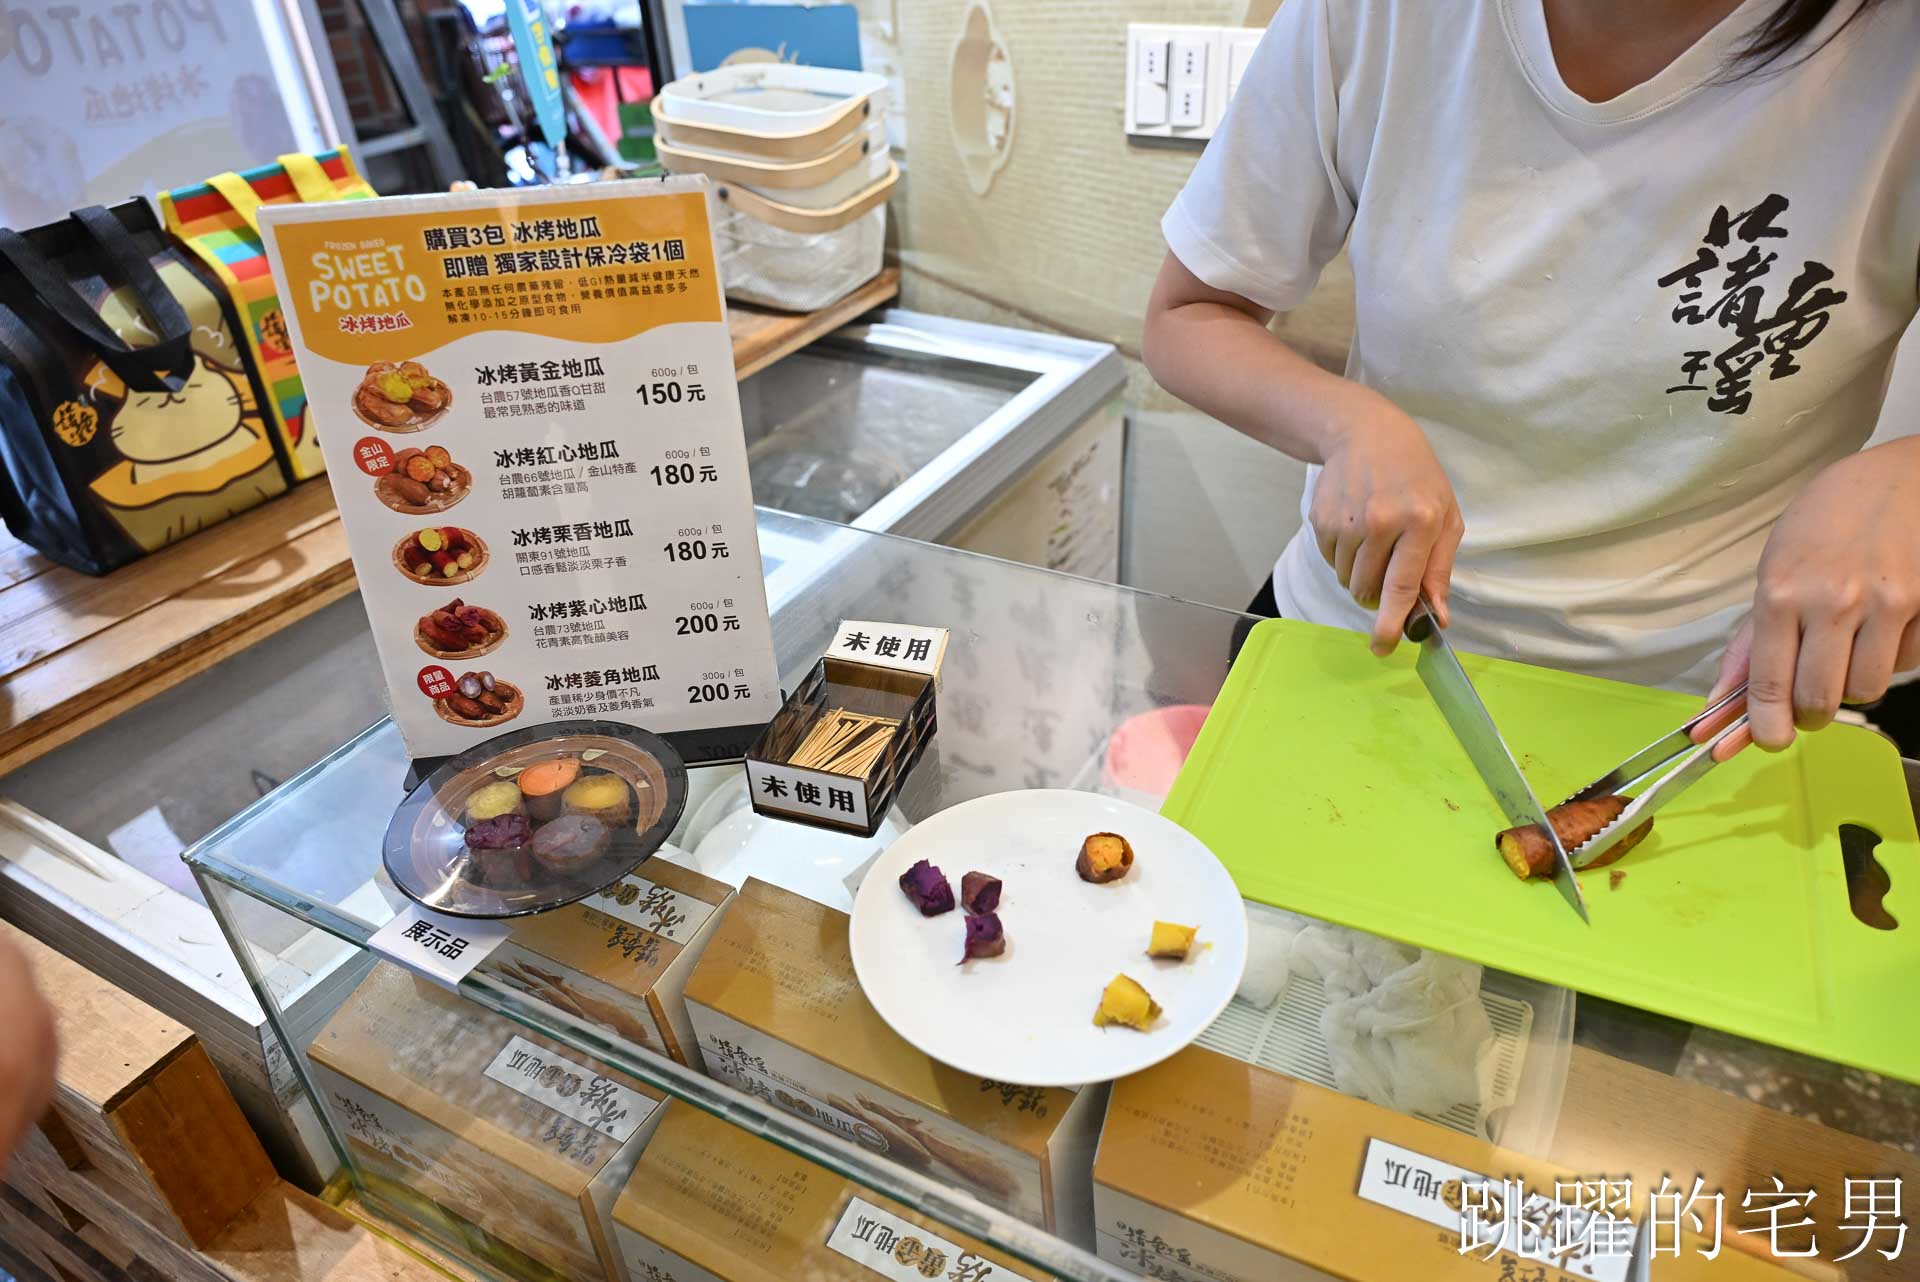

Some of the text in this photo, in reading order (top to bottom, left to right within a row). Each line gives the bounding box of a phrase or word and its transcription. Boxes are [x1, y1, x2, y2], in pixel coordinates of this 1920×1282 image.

[424, 216, 602, 251] 購買3包 冰烤地瓜
[312, 244, 404, 281] SWEET
[443, 239, 685, 279] 即贈 獨家設計保冷袋1個
[309, 274, 426, 312] POTATO
[340, 312, 411, 332] 冰烤地瓜
[475, 357, 605, 386] 冰烤黃金地瓜
[651, 367, 677, 378] 600g
[687, 364, 699, 375] 包
[481, 382, 606, 405] 台農57號地瓜香Q甘甜
[636, 381, 706, 406] 150 元
[484, 400, 585, 418] 最常見熟悉的味道
[360, 443, 383, 459] 金山
[493, 440, 620, 469] 冰烤紅心地瓜
[665, 450, 690, 460] 600g
[700, 447, 710, 457] 包
[365, 456, 391, 472] 限定
[499, 467, 576, 486] 台農66號地瓜
[587, 462, 638, 477] 金山特產
[650, 463, 718, 486] 180 元
[511, 518, 634, 547] 冰烤栗香地瓜
[678, 528, 702, 537] 600g
[712, 525, 723, 535] 包
[664, 540, 730, 563] 180 元
[519, 556, 627, 576] 口感香鬆淡淡栗子香
[528, 594, 648, 621] 冰烤紫心地瓜
[690, 602, 714, 611] 600g
[723, 599, 734, 608] 包
[534, 619, 606, 637] 台農73號地瓜
[675, 613, 740, 636] 200 元
[843, 631, 932, 661] 未使用
[545, 664, 660, 691] 冰烤菱角地瓜
[702, 671, 725, 681] 300g
[734, 668, 745, 678] 包
[428, 681, 451, 696] 商品
[688, 683, 751, 704] 200 元
[551, 697, 655, 718] 淡淡奶香及菱角香氣
[761, 775, 856, 814] 未使用
[401, 918, 470, 961] 展示品
